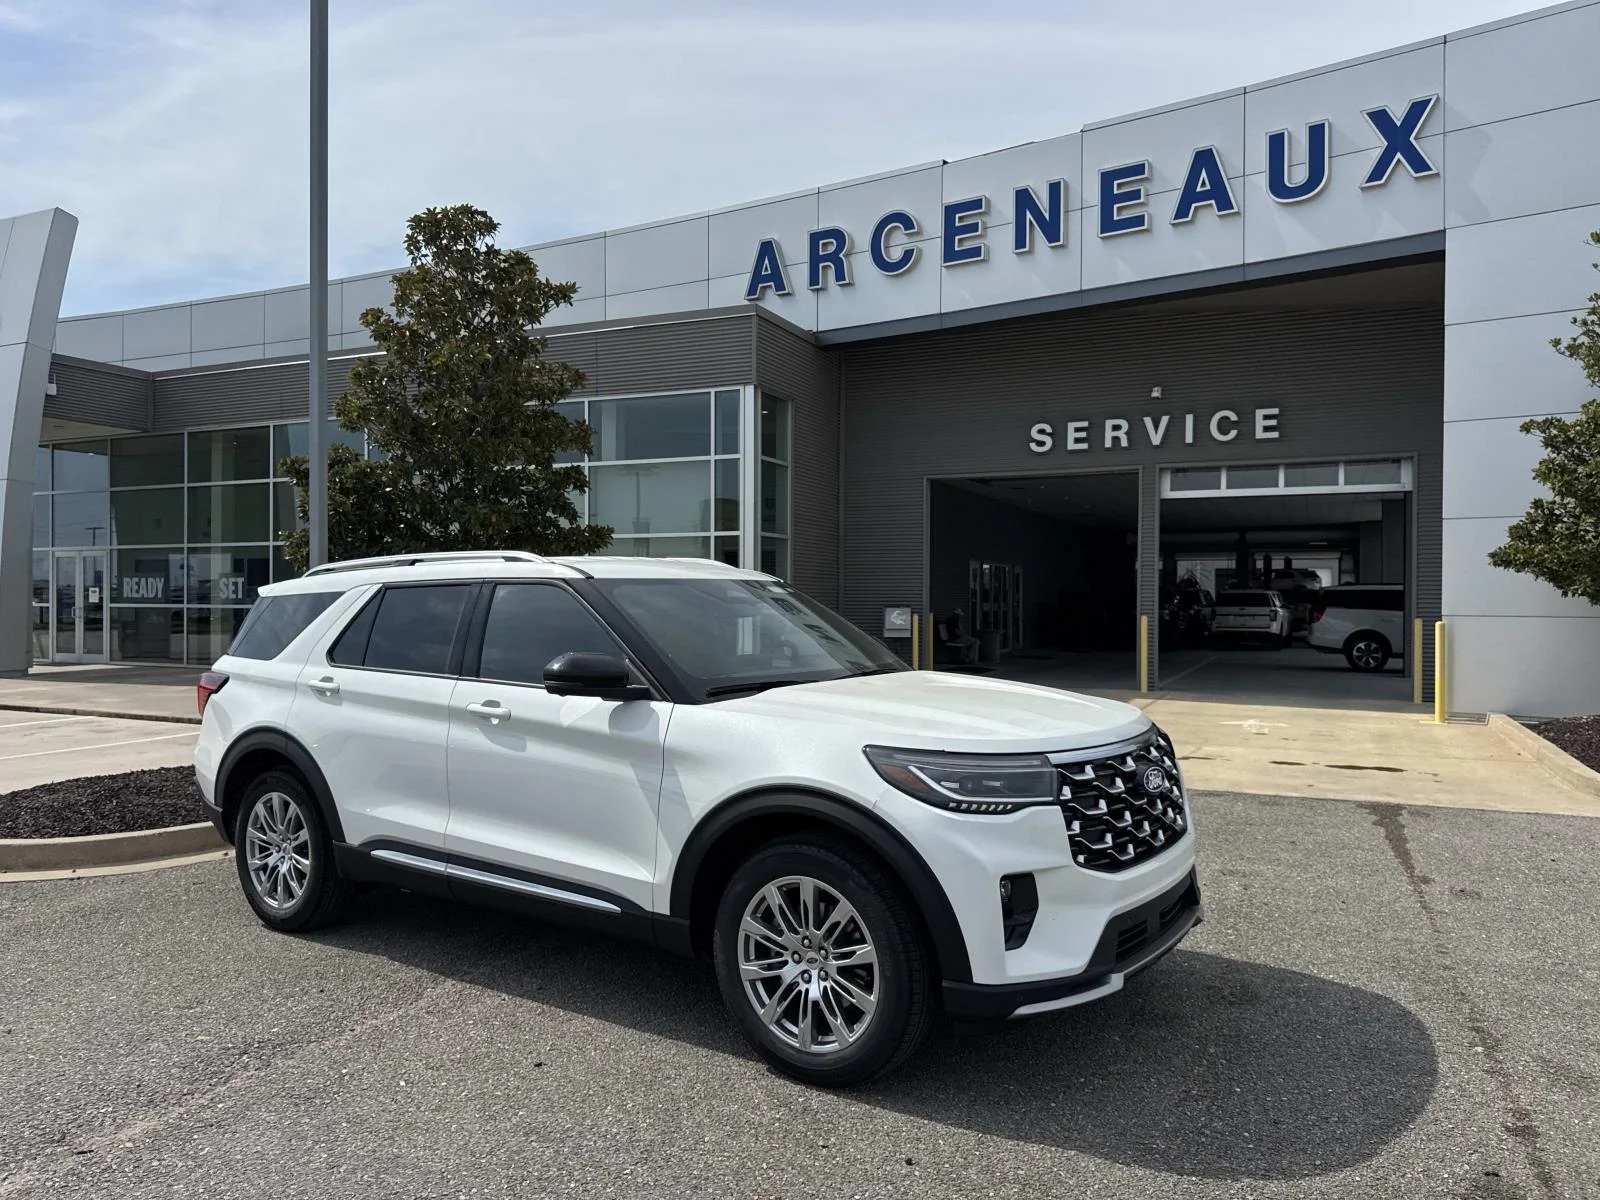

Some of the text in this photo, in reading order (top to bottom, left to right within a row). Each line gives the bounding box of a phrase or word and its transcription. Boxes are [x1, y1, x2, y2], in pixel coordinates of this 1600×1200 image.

[744, 93, 1440, 301] ARCENEAUX
[1029, 408, 1280, 453] SERVICE
[123, 577, 165, 598] READY
[219, 577, 245, 599] SET
